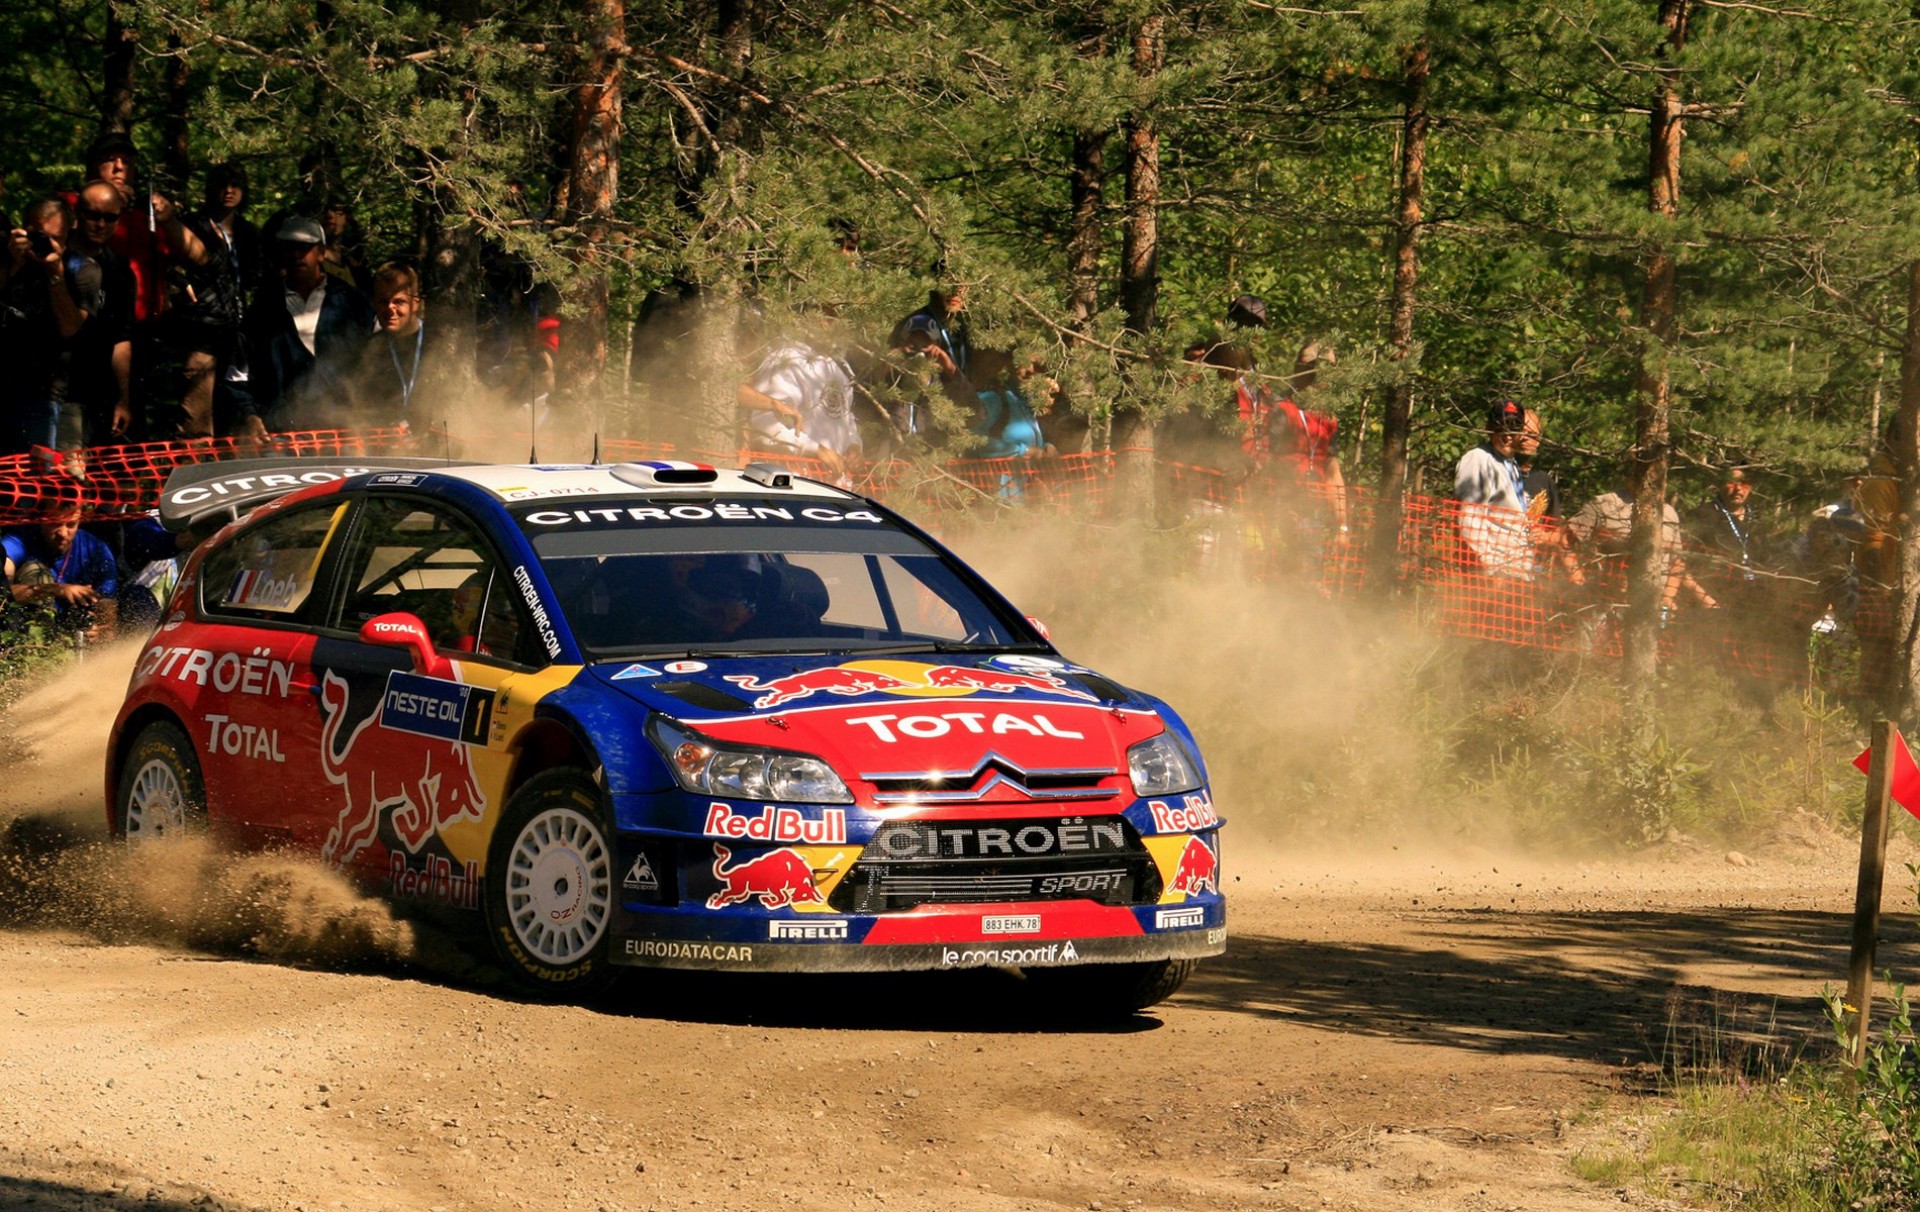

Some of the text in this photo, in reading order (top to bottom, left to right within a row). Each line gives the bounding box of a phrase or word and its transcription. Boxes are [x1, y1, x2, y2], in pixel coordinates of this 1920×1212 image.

[525, 503, 883, 525] CITROËN C4
[374, 622, 417, 633] TOTAL
[513, 565, 562, 659] CITROEN-WRC.COM
[135, 645, 295, 698] CITROËN
[438, 700, 461, 723] OIL
[474, 699, 486, 737] 1
[204, 713, 286, 763] TOTAL
[845, 712, 1085, 743] TOTAL
[703, 801, 847, 844] Red Bull
[1147, 796, 1202, 834] Red
[879, 816, 1128, 857] CITROËN
[389, 849, 480, 911] Red Bull
[1039, 873, 1127, 894] SPORT
[769, 919, 849, 939] PIRELLI
[985, 918, 1037, 931] 883 EHK 78
[1155, 906, 1204, 930] PIRELLI
[500, 926, 592, 983] SCORPION
[625, 940, 753, 962] EURODATACAR
[942, 946, 959, 966] le
[1000, 944, 1059, 964] sportif
